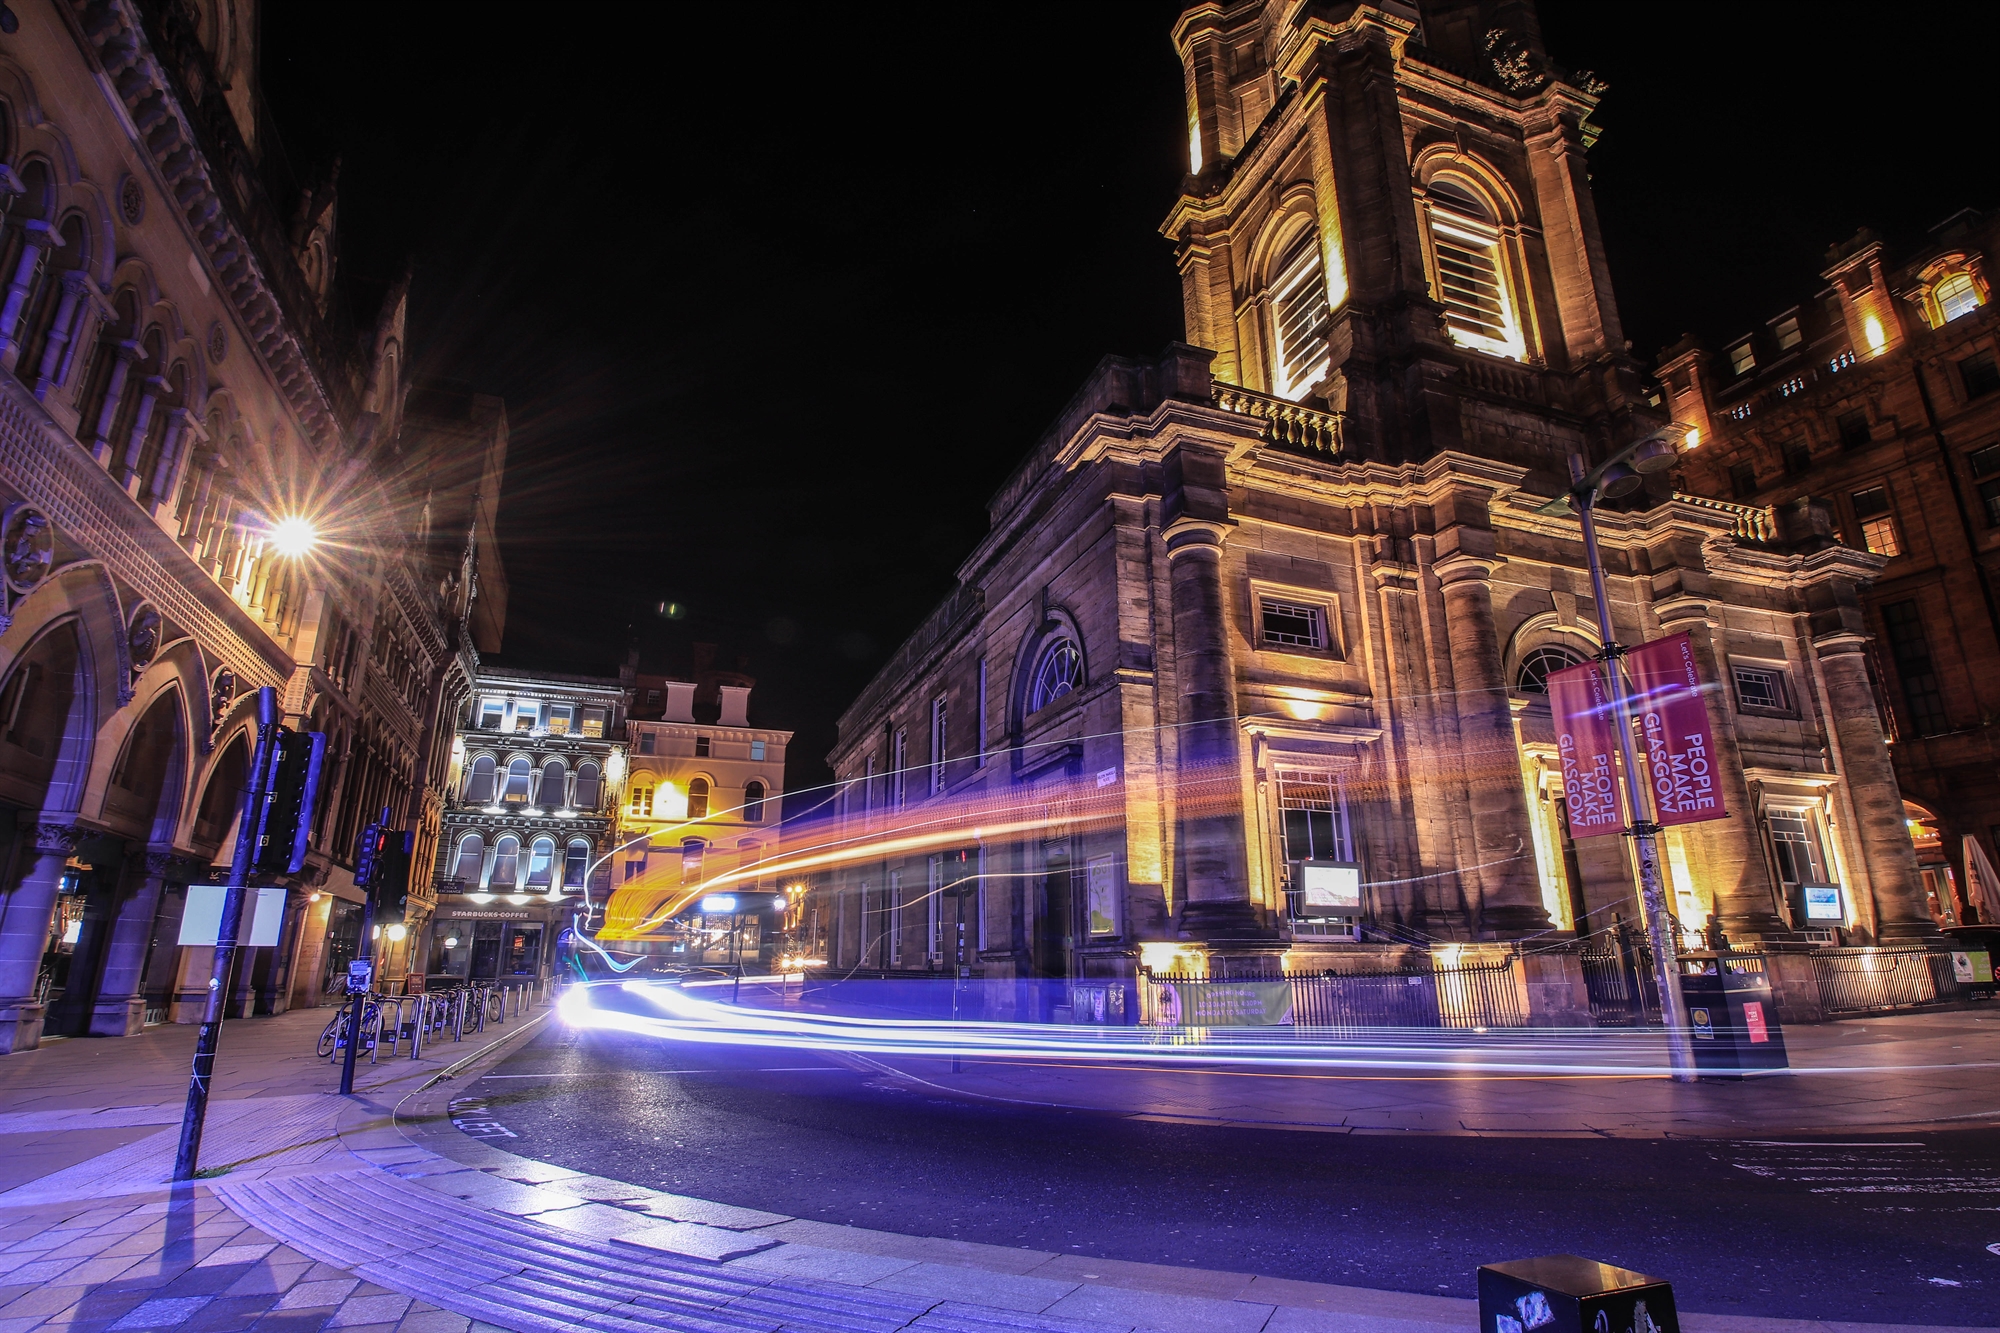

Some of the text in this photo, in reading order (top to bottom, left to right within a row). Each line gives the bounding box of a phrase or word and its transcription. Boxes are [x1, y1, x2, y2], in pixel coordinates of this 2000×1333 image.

[1680, 641, 1698, 698] Let's Celebrate
[1559, 733, 1587, 827] GLASGOW
[1592, 753, 1617, 824] PEOPLE
[1644, 712, 1678, 814] GLASGOW
[1669, 753, 1696, 813] MAKE
[1684, 733, 1715, 809] PEOPLE
[1580, 772, 1601, 826] MAKE
[452, 910, 498, 918] STARBUCKS
[1195, 1009, 1225, 1017] MONDAY
[1235, 1007, 1267, 1016] SATURDAY
[1235, 989, 1256, 998] HOURS
